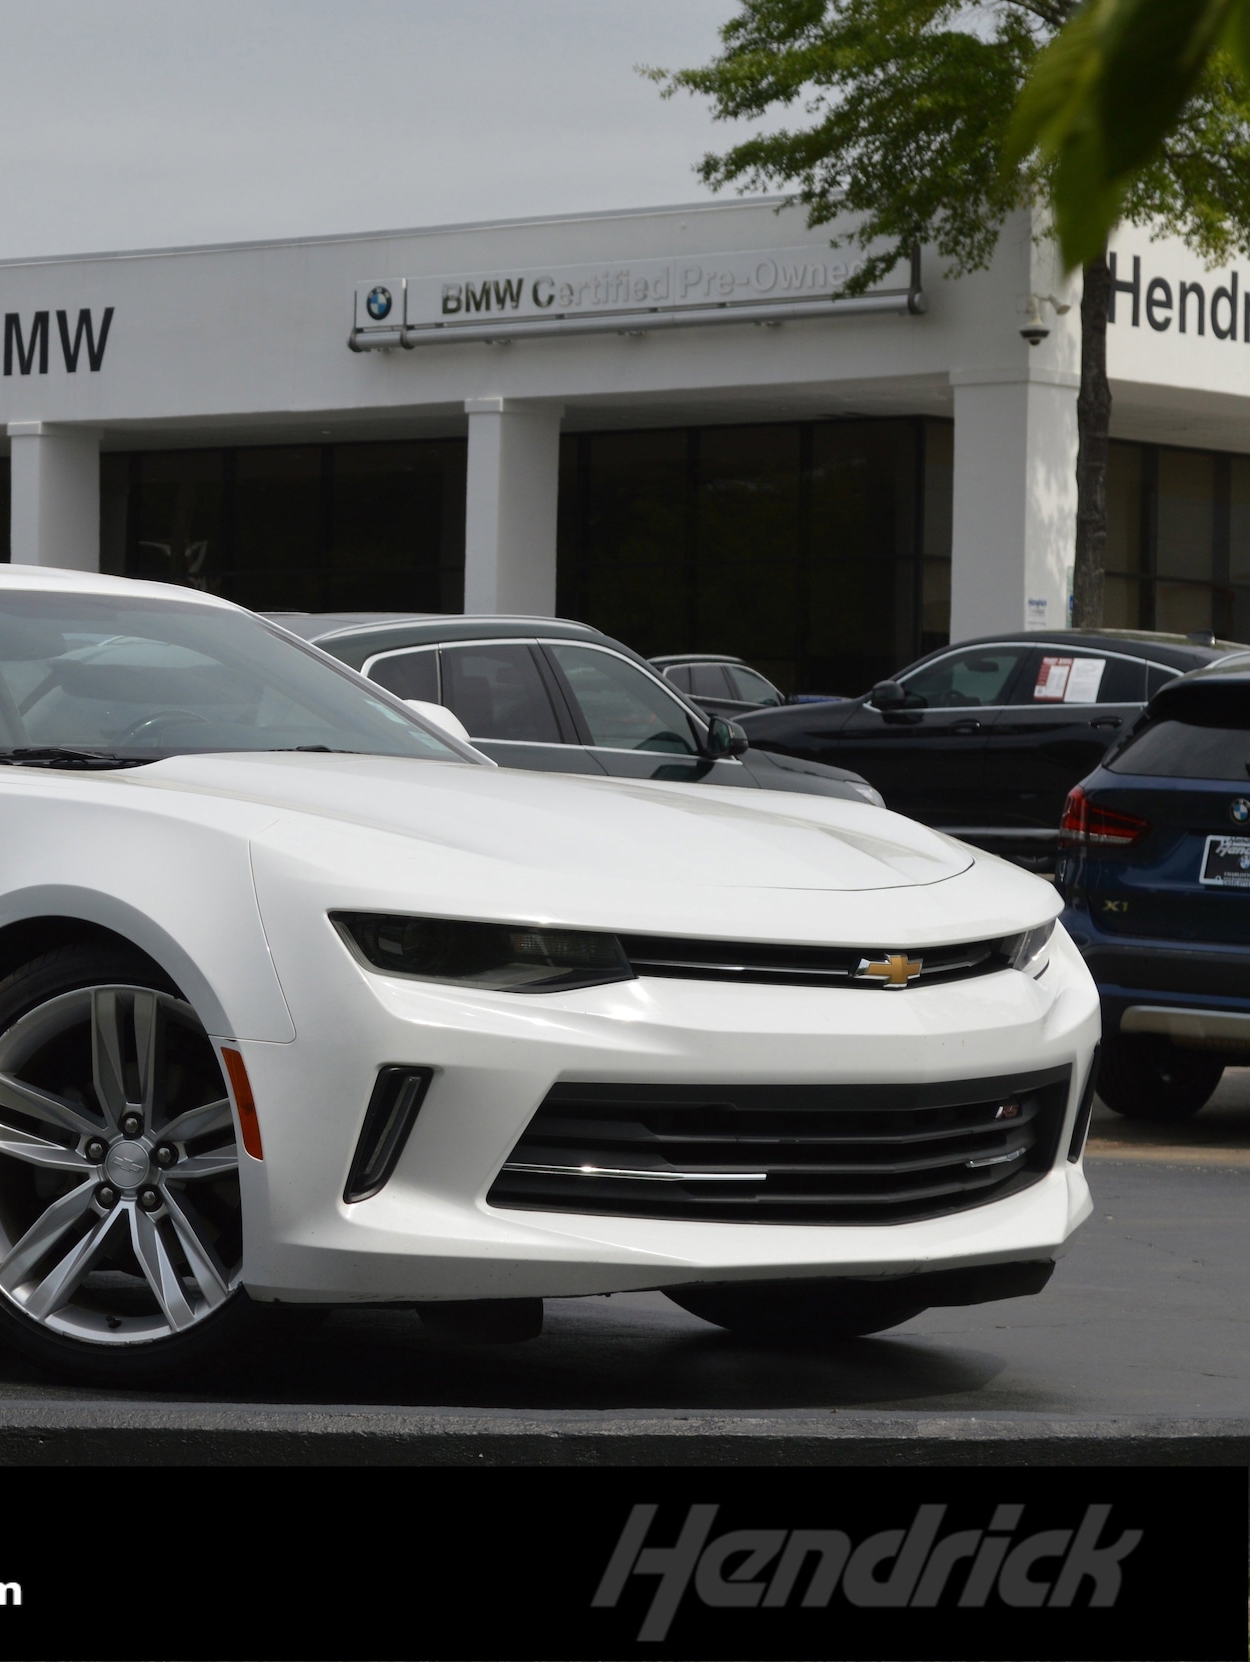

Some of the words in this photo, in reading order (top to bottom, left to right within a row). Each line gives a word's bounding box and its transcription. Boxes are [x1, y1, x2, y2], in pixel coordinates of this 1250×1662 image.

[441, 277, 524, 315] BMW
[532, 267, 670, 310] Certified
[1102, 899, 1129, 912] X1
